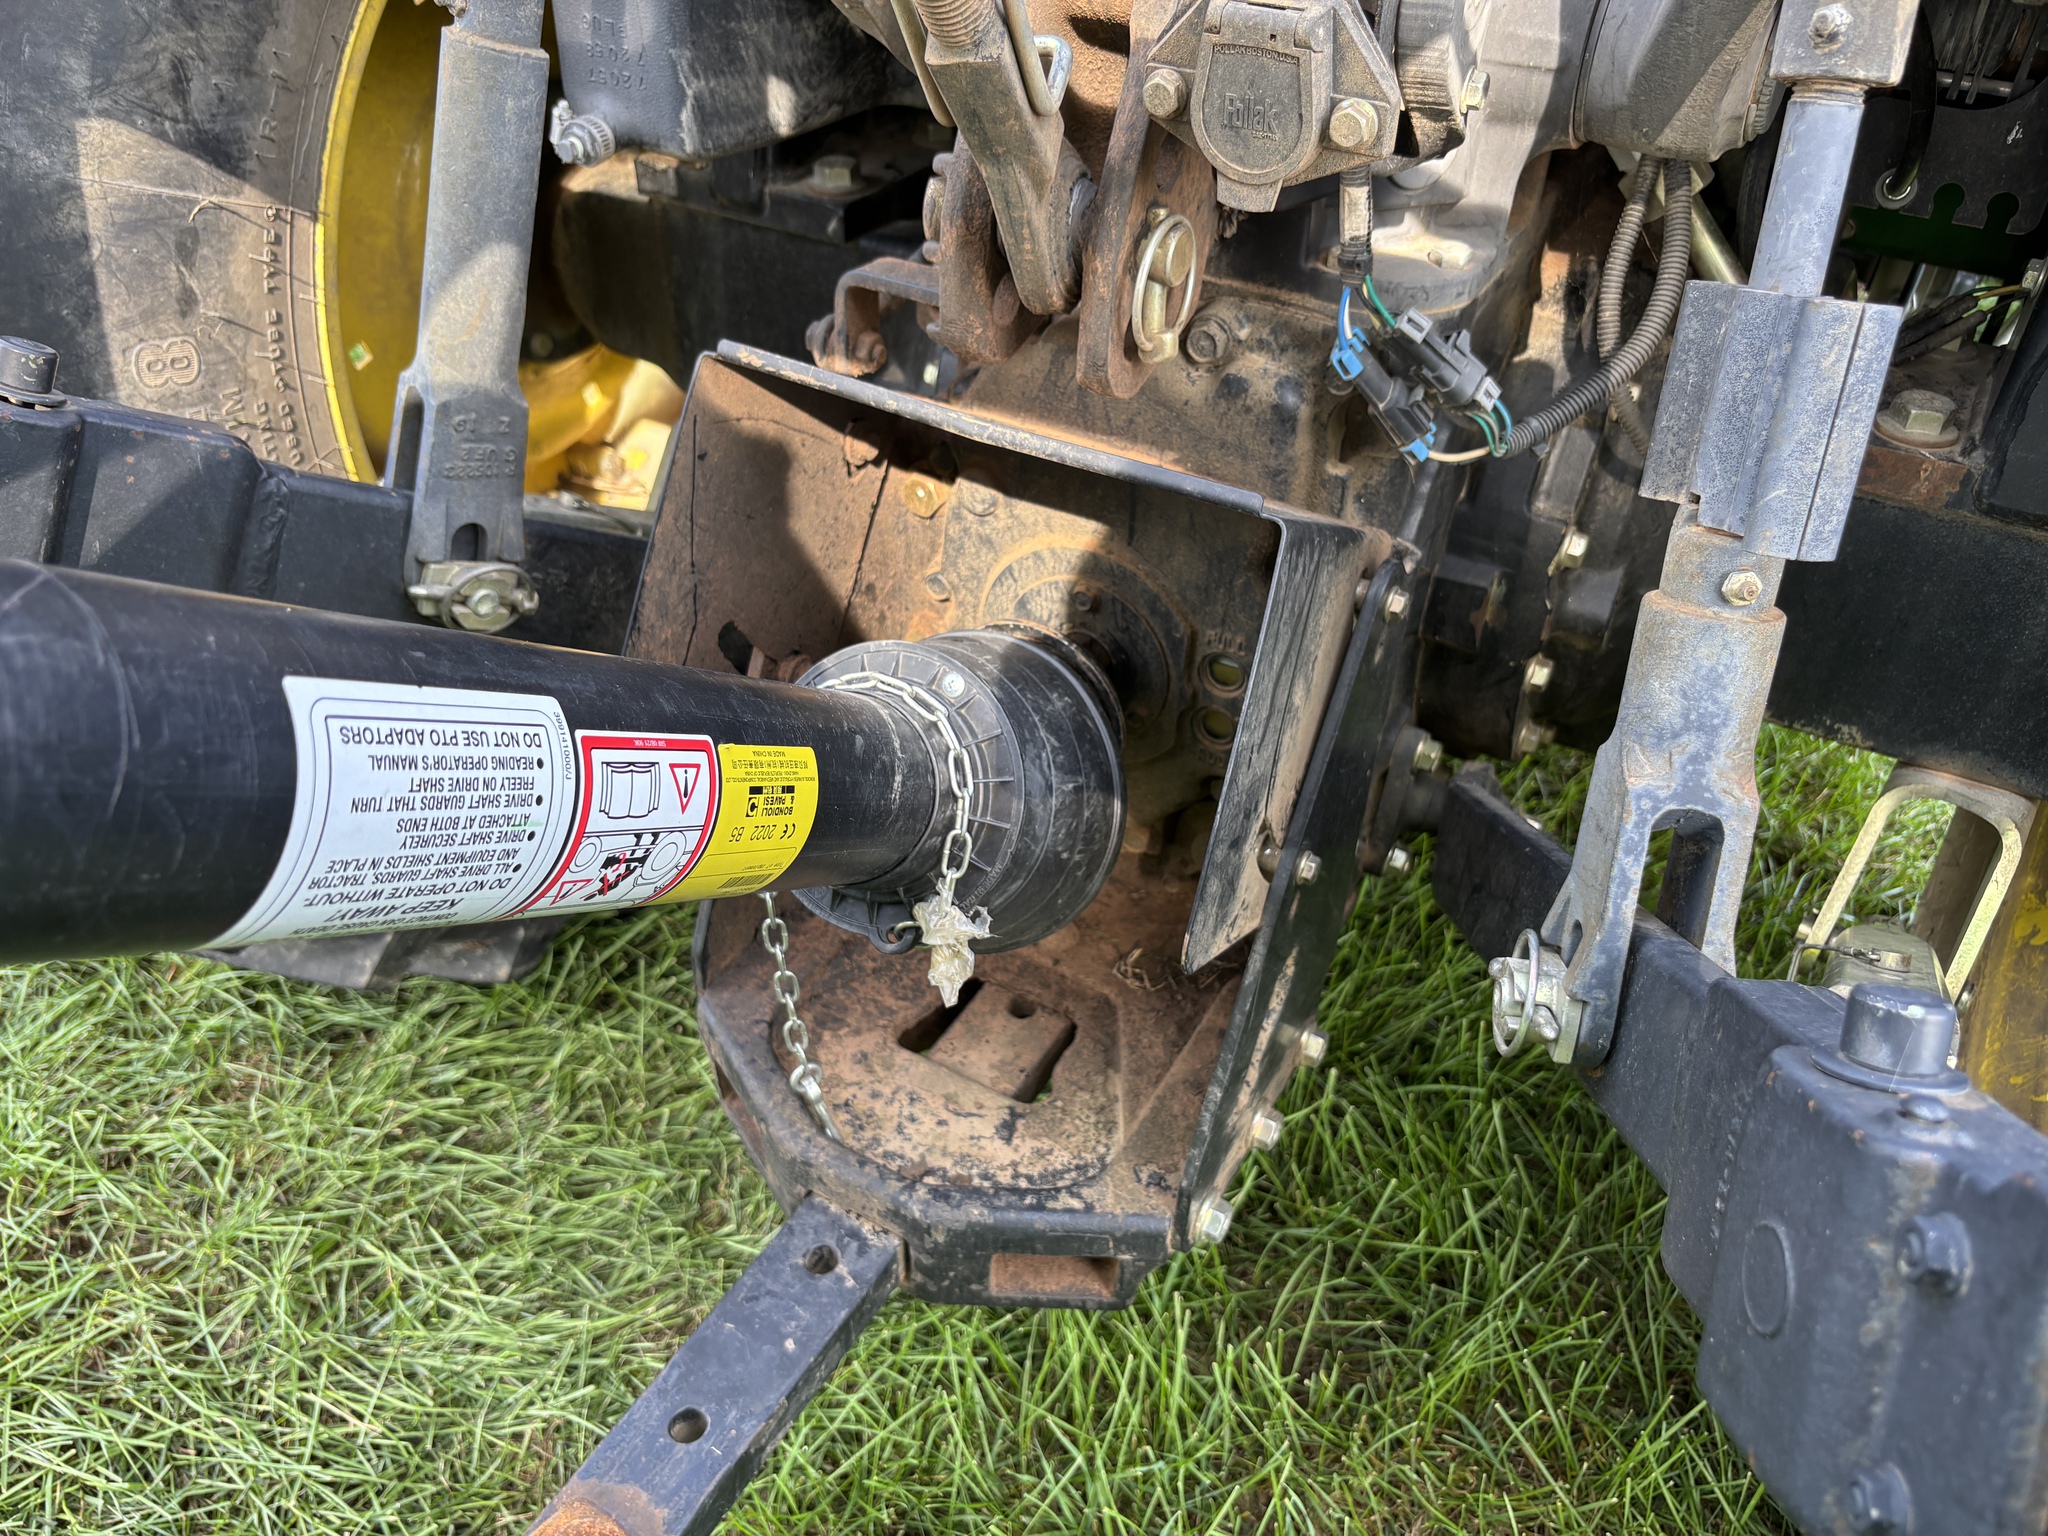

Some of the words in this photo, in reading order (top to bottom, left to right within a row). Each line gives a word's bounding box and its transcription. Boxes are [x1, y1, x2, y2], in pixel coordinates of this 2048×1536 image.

[1214, 44, 1246, 54] POLLAK
[1223, 93, 1278, 133] Pollak
[133, 338, 200, 388] 8
[339, 726, 425, 746] ADAPTORS
[429, 729, 459, 746] PTO
[461, 730, 490, 747] USE
[493, 731, 520, 748] NOT
[523, 732, 542, 748] DO
[368, 754, 418, 770] MANUAL
[422, 755, 488, 771] OPERATOR'S
[491, 756, 534, 771] READING
[408, 777, 445, 793] SHAFT
[448, 777, 479, 792] DRIVE
[482, 777, 497, 792] ON
[500, 776, 535, 791] FREELY
[350, 796, 383, 813] TURN
[386, 796, 416, 812] THAT
[420, 795, 465, 811] GUARDS
[468, 794, 502, 809] SHAFT
[504, 793, 534, 808] DRIVE
[763, 796, 786, 806] PAVESI
[790, 795, 795, 805] &
[761, 806, 793, 817] BONDIOLI
[396, 817, 428, 833] ENDS
[430, 816, 460, 832] BOTH
[461, 815, 477, 830] AT
[479, 813, 531, 829] ATTACHED
[458, 830, 494, 846] SHAFT
[494, 829, 526, 844] DRIVE
[728, 826, 745, 843] B5
[750, 824, 777, 842] 2022
[399, 833, 457, 850] SECURELY
[386, 853, 434, 869] SHIELDS
[434, 849, 497, 866] EQUIPMENT
[497, 847, 521, 861] AND
[325, 858, 368, 874] PLACE
[370, 856, 384, 871] IN
[461, 864, 493, 878] DRIVE
[493, 862, 514, 875] ALL
[372, 869, 421, 885] GUARDS,
[420, 866, 460, 880] SHAFT
[307, 873, 368, 890] TRACTOR
[455, 879, 490, 893] NOT
[488, 877, 513, 890] DO
[384, 882, 456, 900] OPERATE
[323, 903, 407, 922] AWAY!
[401, 898, 464, 915] KEEP
